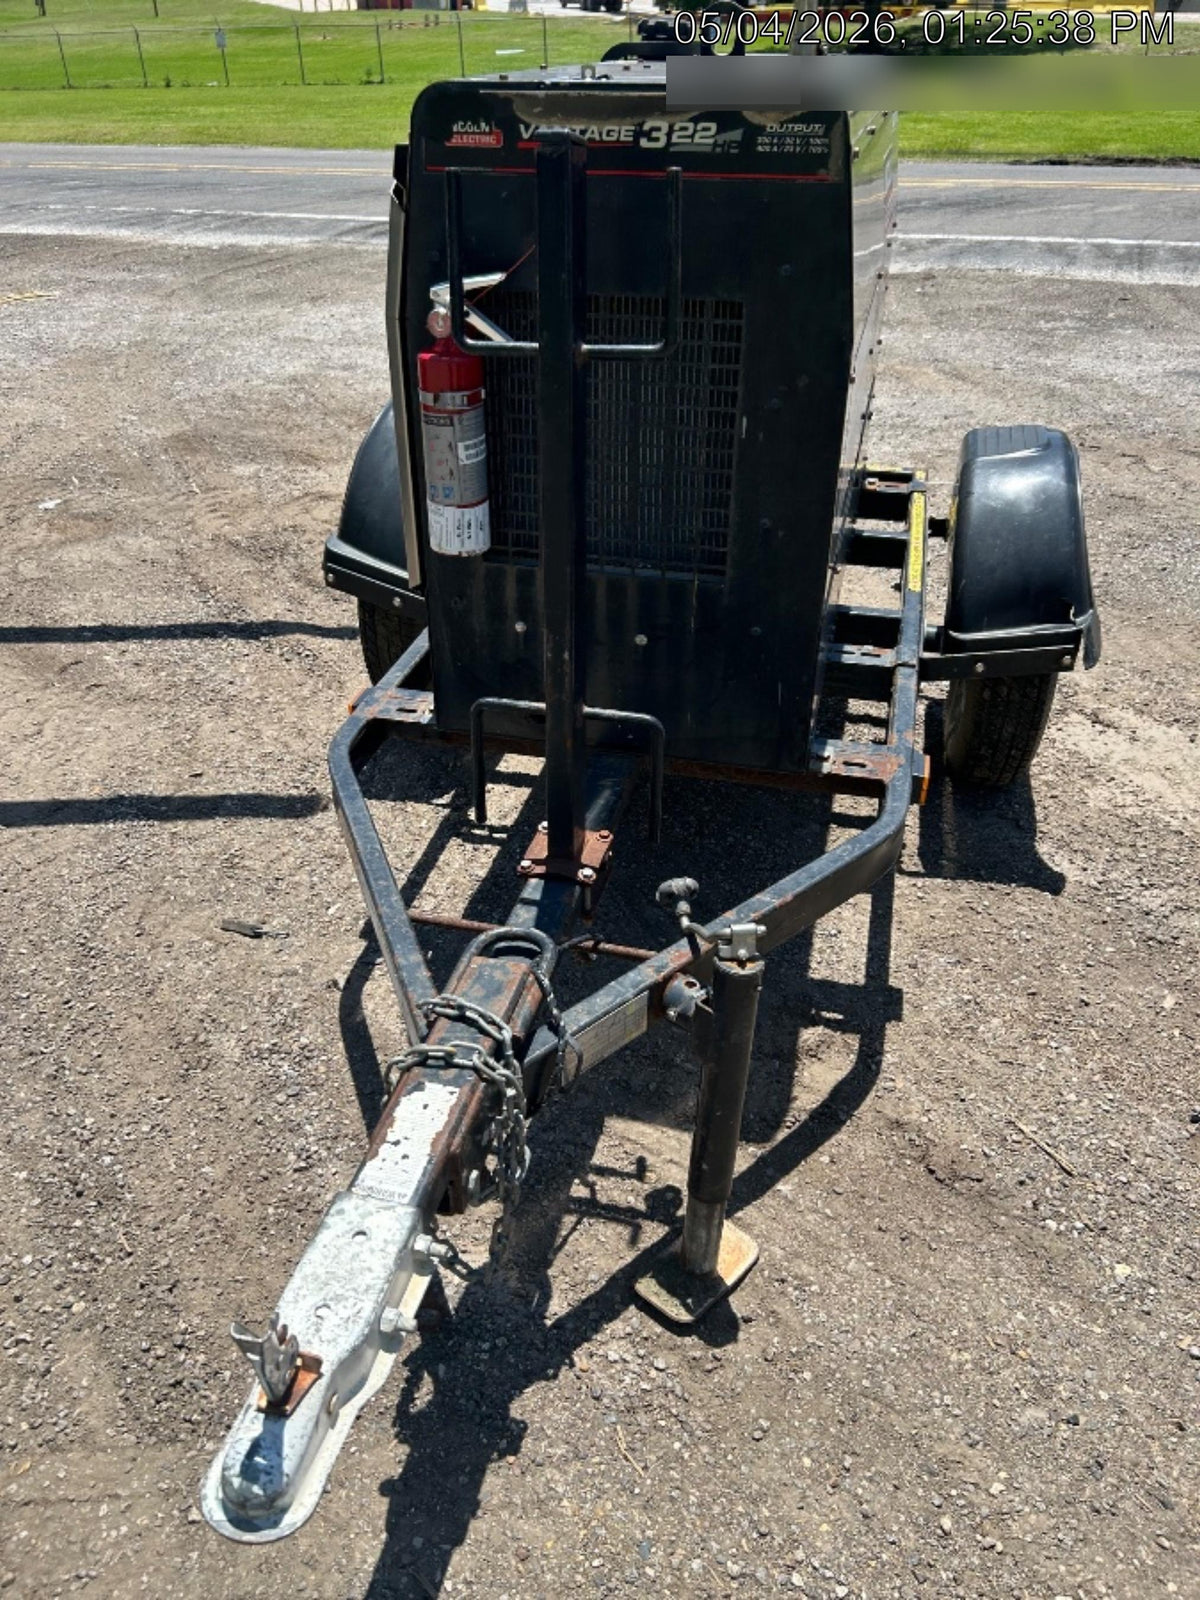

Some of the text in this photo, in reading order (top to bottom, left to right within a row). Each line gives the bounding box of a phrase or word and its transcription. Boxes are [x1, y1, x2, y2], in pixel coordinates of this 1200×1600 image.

[518, 123, 635, 142] VTAGE
[639, 120, 718, 148] 322
[766, 123, 822, 132] OUTPUT
